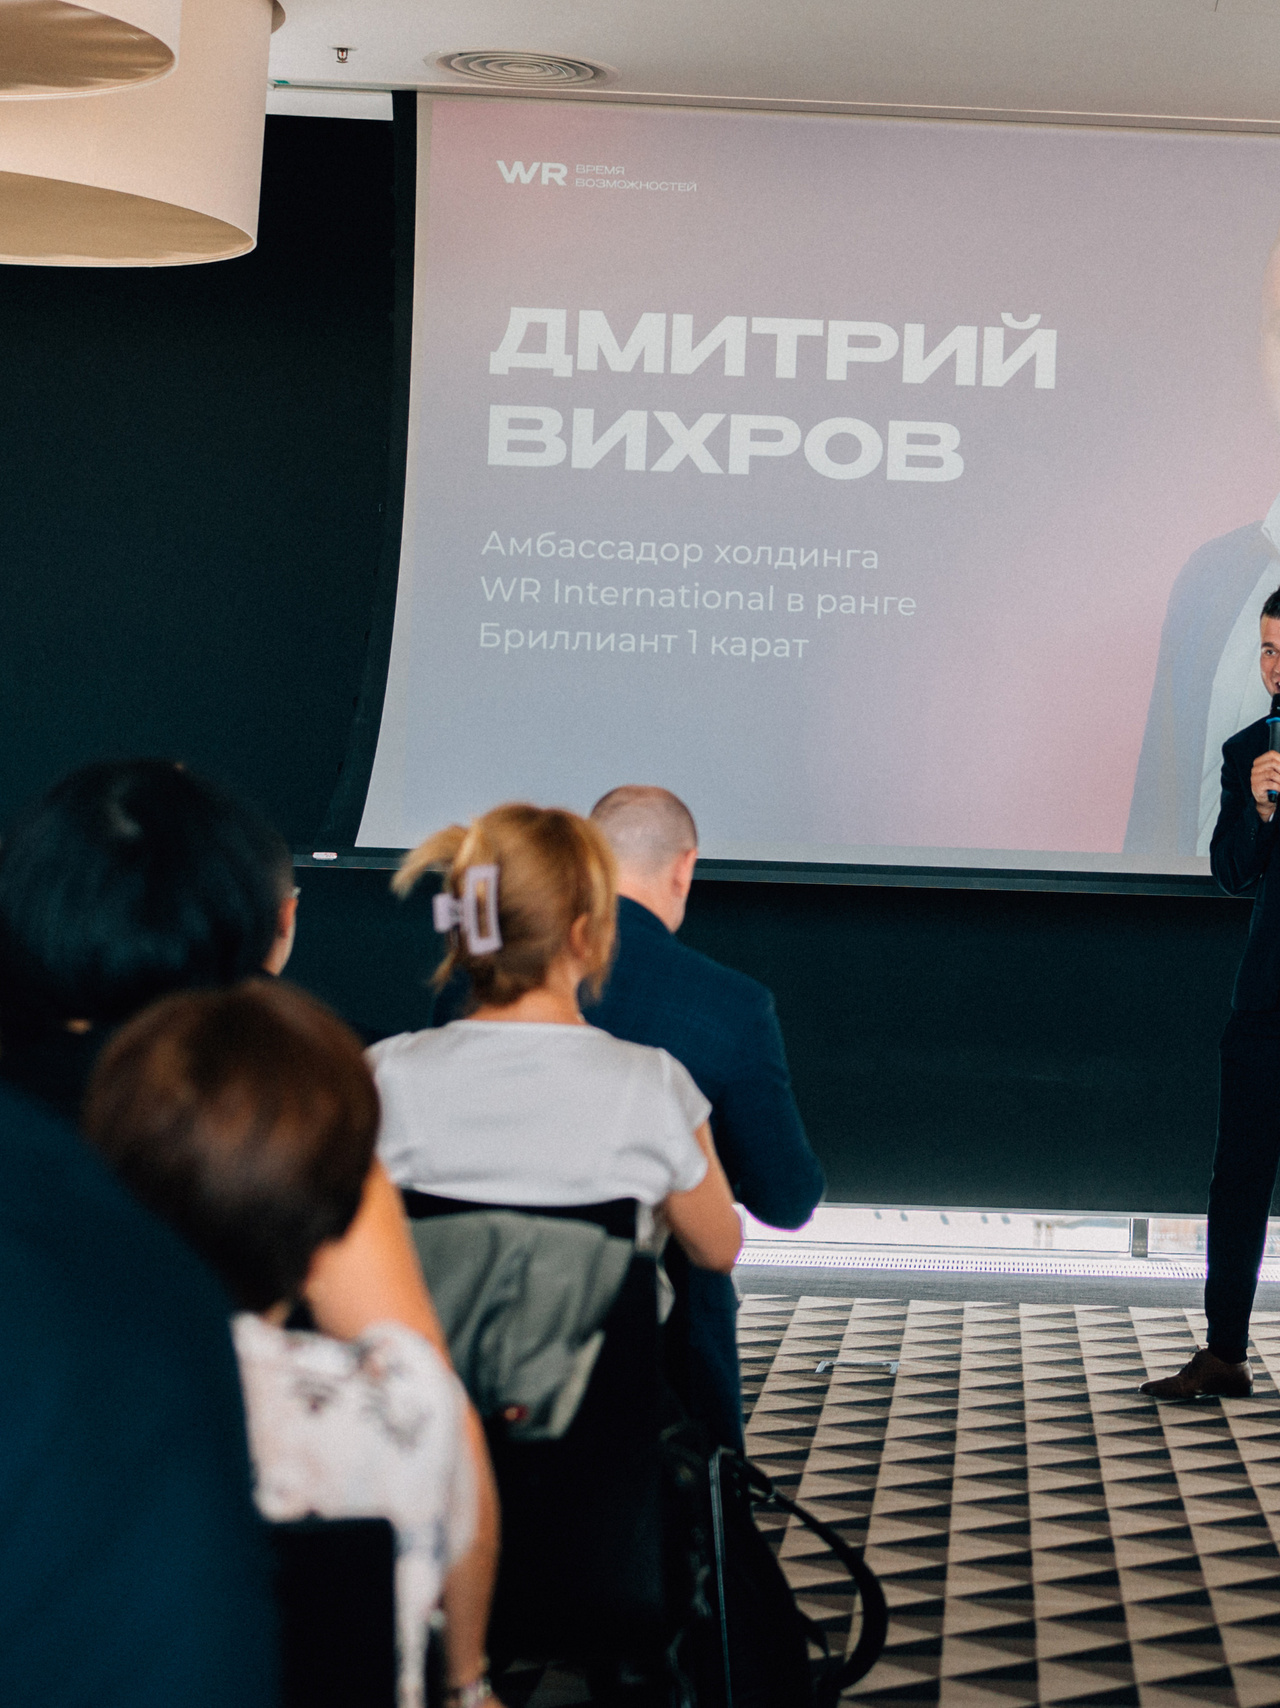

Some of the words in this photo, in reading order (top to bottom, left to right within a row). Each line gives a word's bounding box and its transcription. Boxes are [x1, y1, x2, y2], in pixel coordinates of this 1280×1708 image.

[496, 160, 568, 186] WR
[575, 164, 625, 175] ВРЕМЯ
[575, 178, 697, 192] ВОЗМОЖНОСТЕЙ
[489, 306, 1057, 389] ДМИТРИЙ
[487, 404, 965, 483] ВИХРОВ
[481, 530, 703, 568] Амбассадор
[714, 540, 879, 570] холдинга
[480, 575, 542, 603] WR
[554, 579, 774, 611] International
[787, 593, 804, 612] в
[817, 594, 917, 619] ранге
[479, 622, 678, 654] Бриллиант
[687, 629, 698, 654] 1
[710, 634, 809, 662] карат
